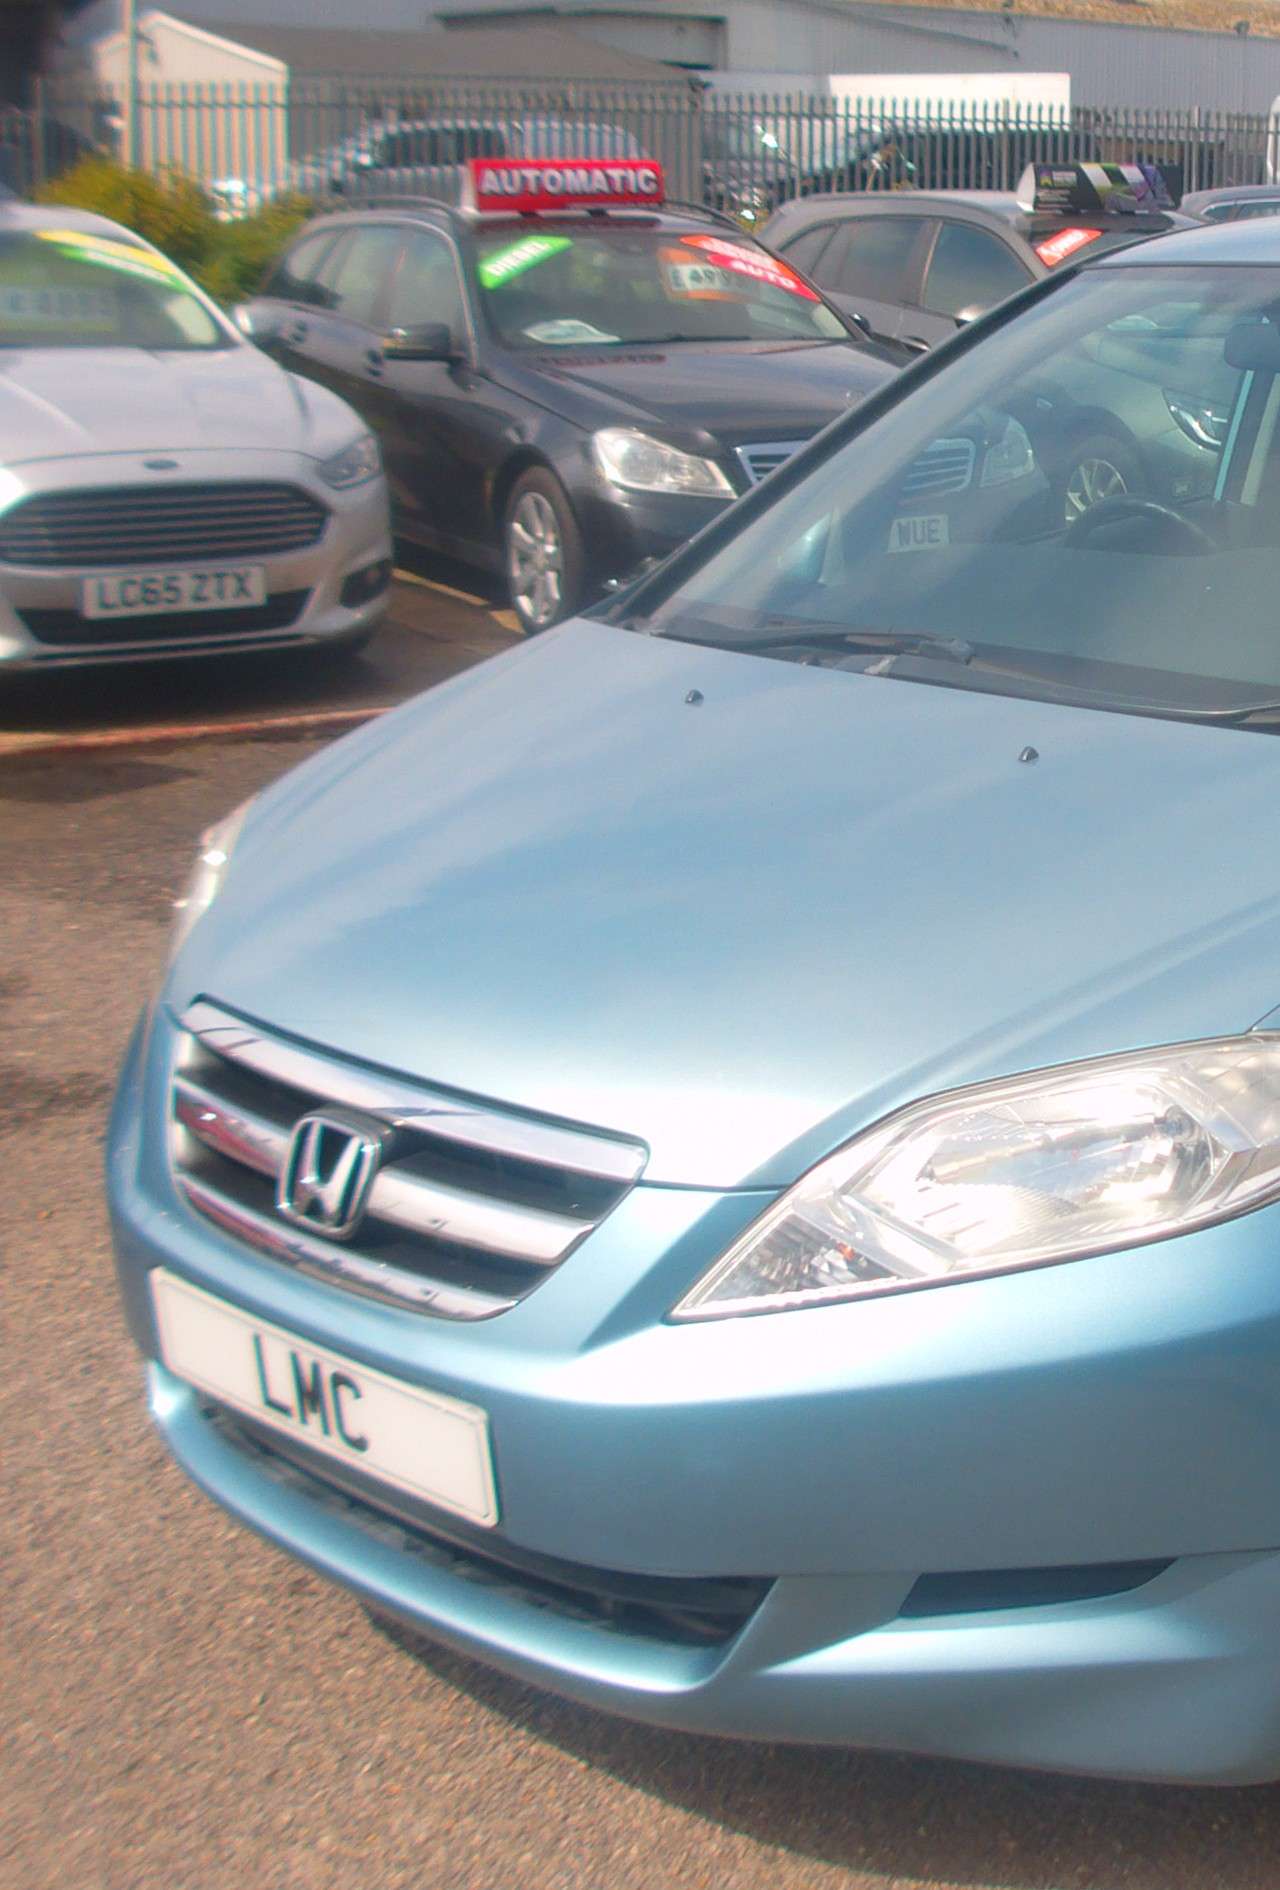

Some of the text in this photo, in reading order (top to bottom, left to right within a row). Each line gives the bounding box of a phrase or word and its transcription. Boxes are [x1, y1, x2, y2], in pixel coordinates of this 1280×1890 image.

[480, 168, 659, 196] AUTOMATIC
[729, 259, 798, 290] AUTO
[97, 571, 253, 610] LC65 ZTX
[253, 1332, 369, 1453] LMC
